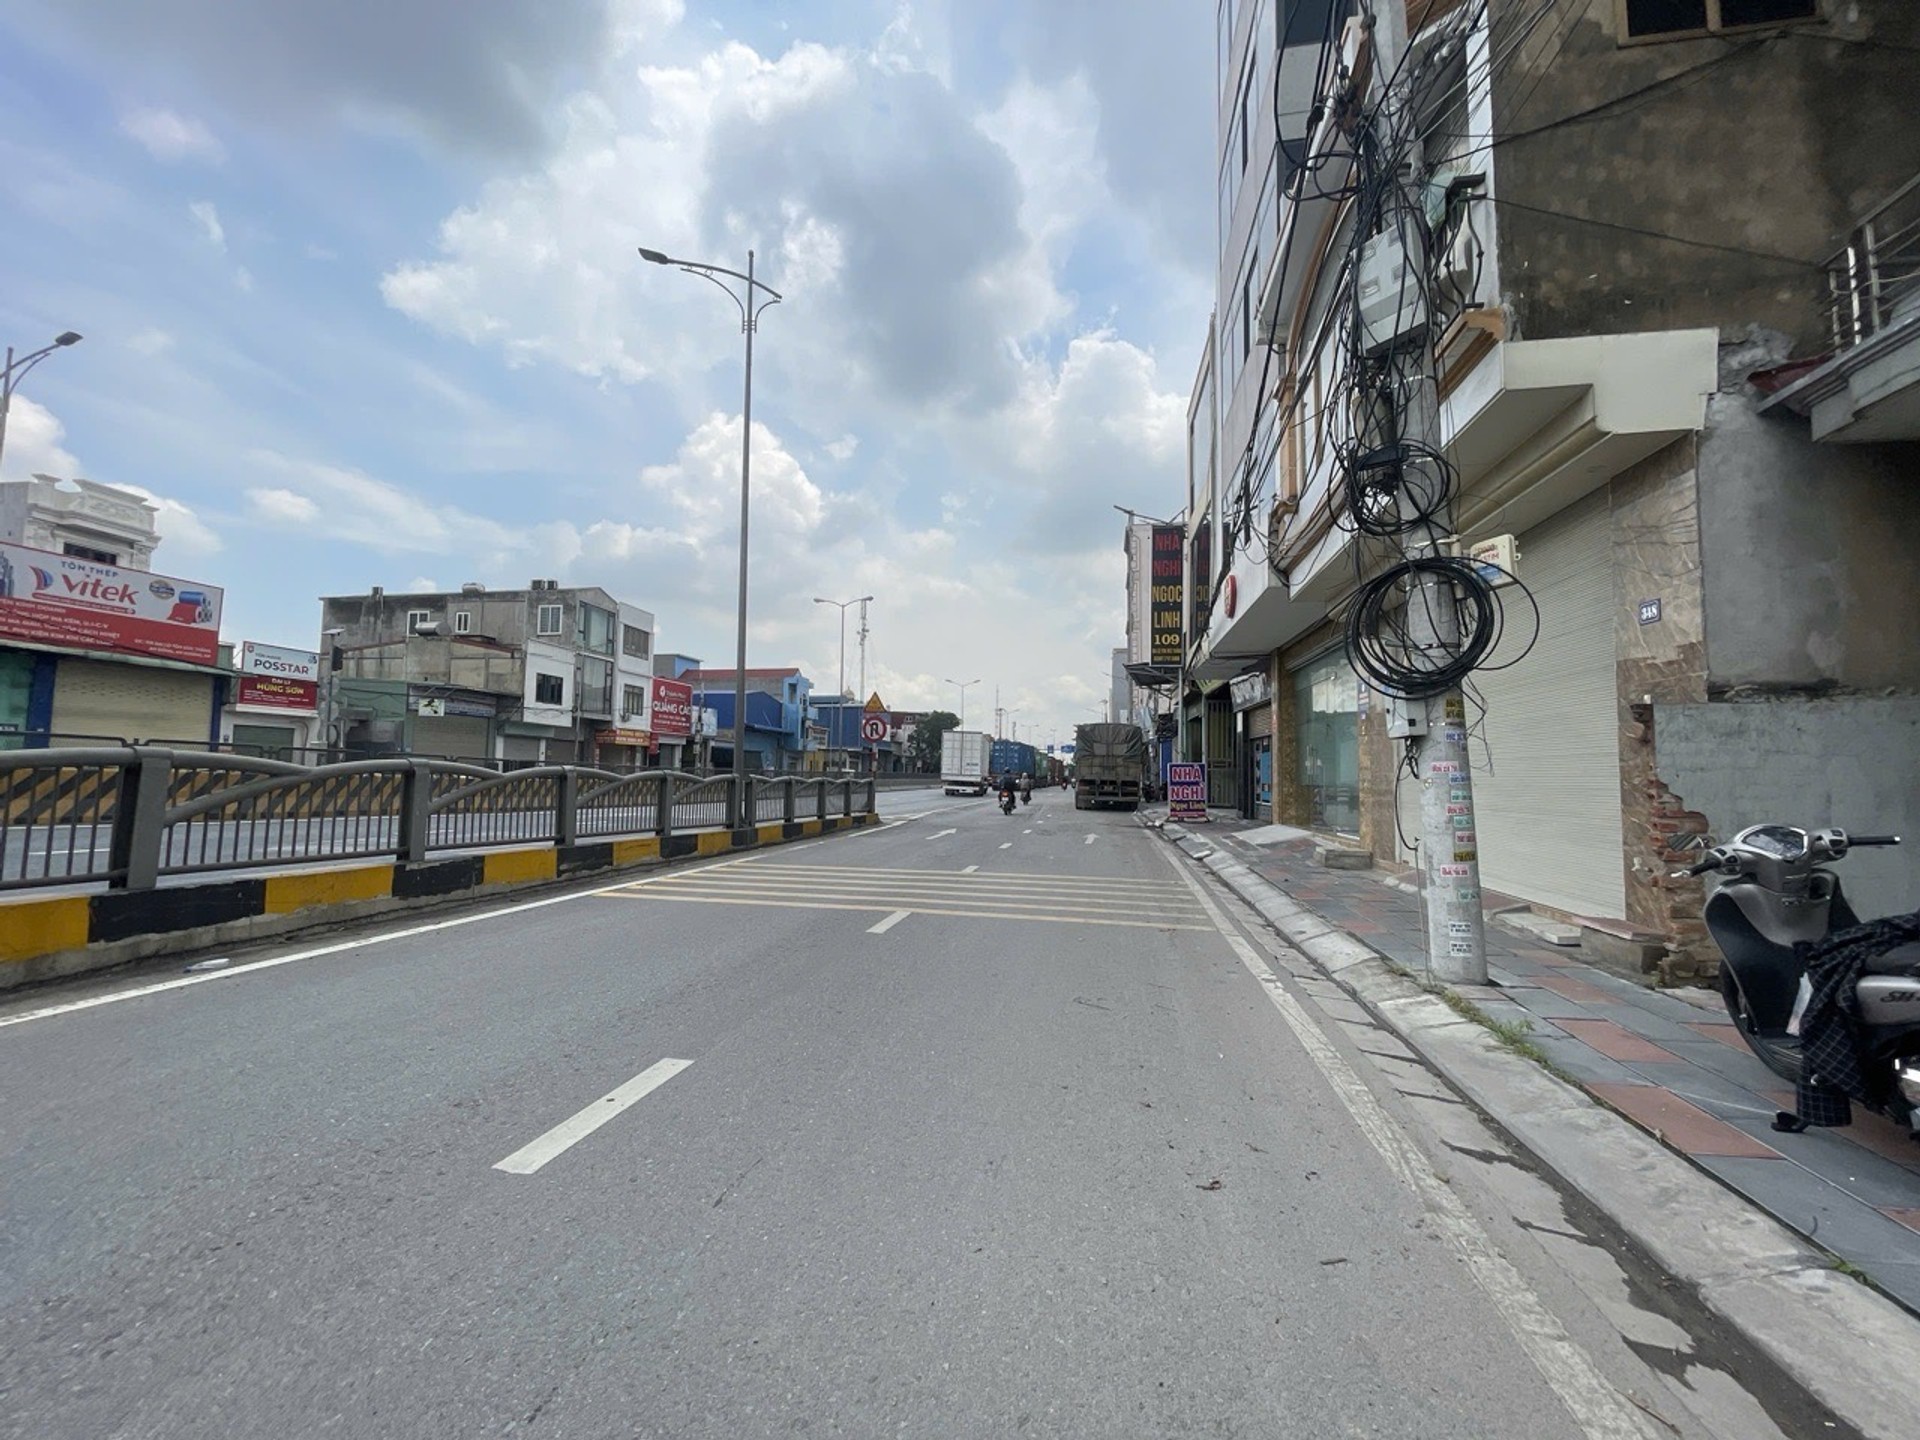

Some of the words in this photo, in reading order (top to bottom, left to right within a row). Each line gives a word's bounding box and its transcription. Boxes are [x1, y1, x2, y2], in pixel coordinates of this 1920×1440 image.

[1154, 531, 1180, 550] NHÀ
[61, 561, 86, 571] TÔN
[1153, 556, 1181, 577] NGHỈ
[1152, 585, 1182, 606] NGỌC
[1154, 611, 1180, 628] LINH
[1153, 634, 1181, 645] 109
[254, 659, 309, 674] POSSTAR
[1171, 765, 1203, 781] NHÀ
[1170, 782, 1206, 800] NGHỈ
